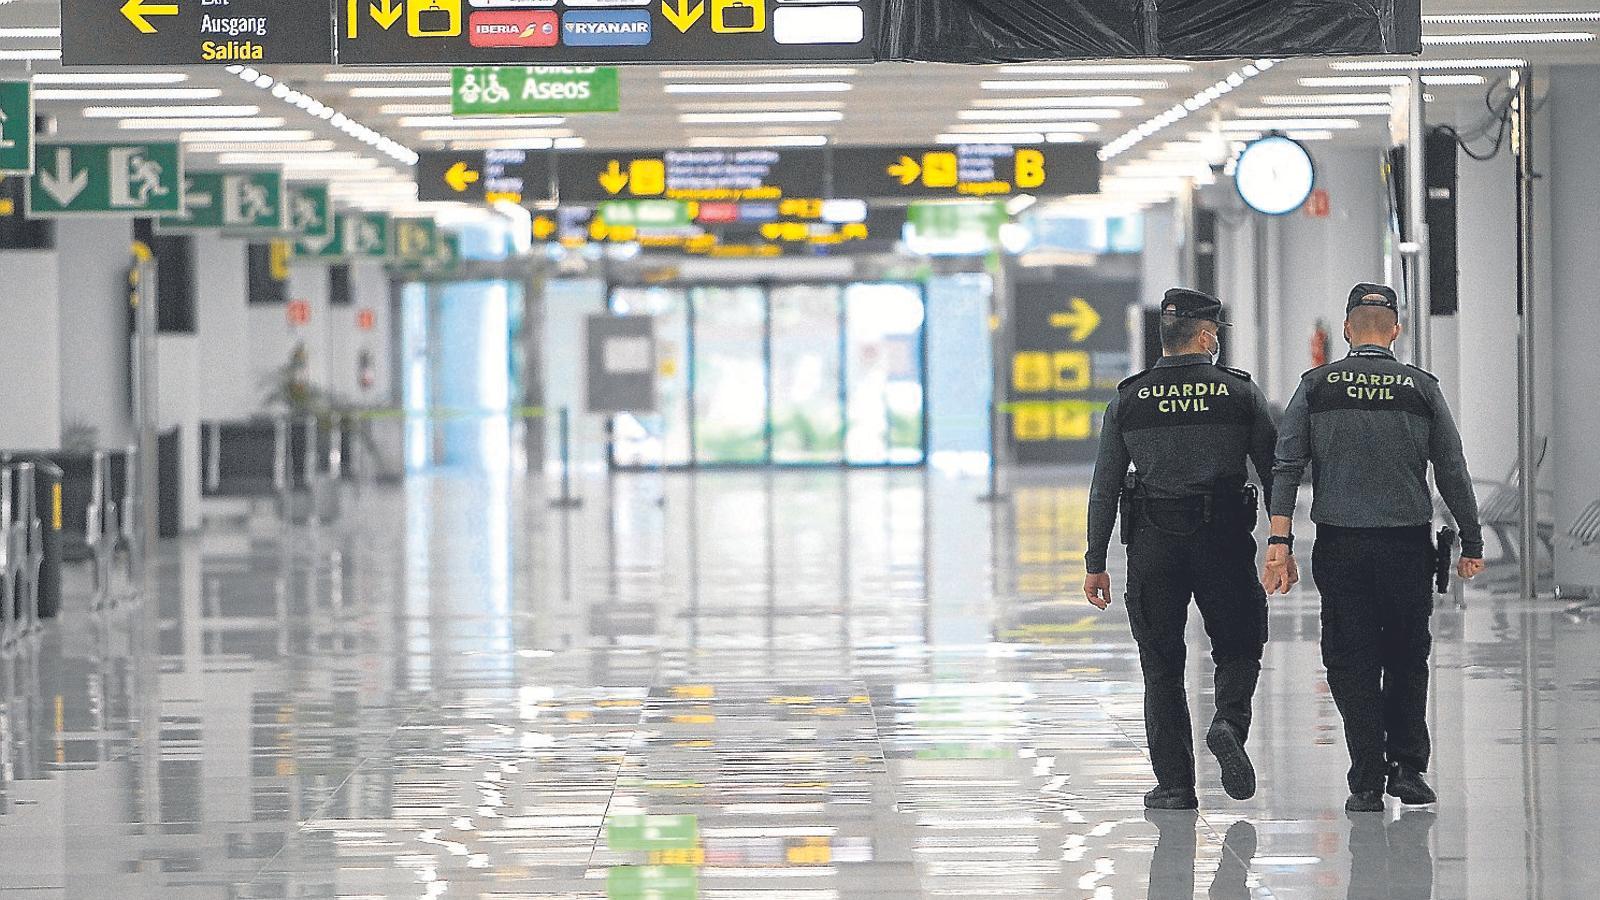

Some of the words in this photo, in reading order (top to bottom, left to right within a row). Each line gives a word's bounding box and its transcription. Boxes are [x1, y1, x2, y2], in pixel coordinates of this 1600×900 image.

[200, 14, 267, 36] Ausgang
[475, 25, 520, 33] IBERIA
[575, 22, 649, 33] RYANAIR
[201, 41, 263, 60] Salida
[522, 78, 590, 99] Aseos
[1015, 149, 1045, 188] B
[1328, 371, 1415, 388] GUARDIA
[1137, 382, 1230, 399] GUARDIA
[1347, 386, 1394, 400] CIVIL
[1158, 398, 1209, 412] CIVIL
